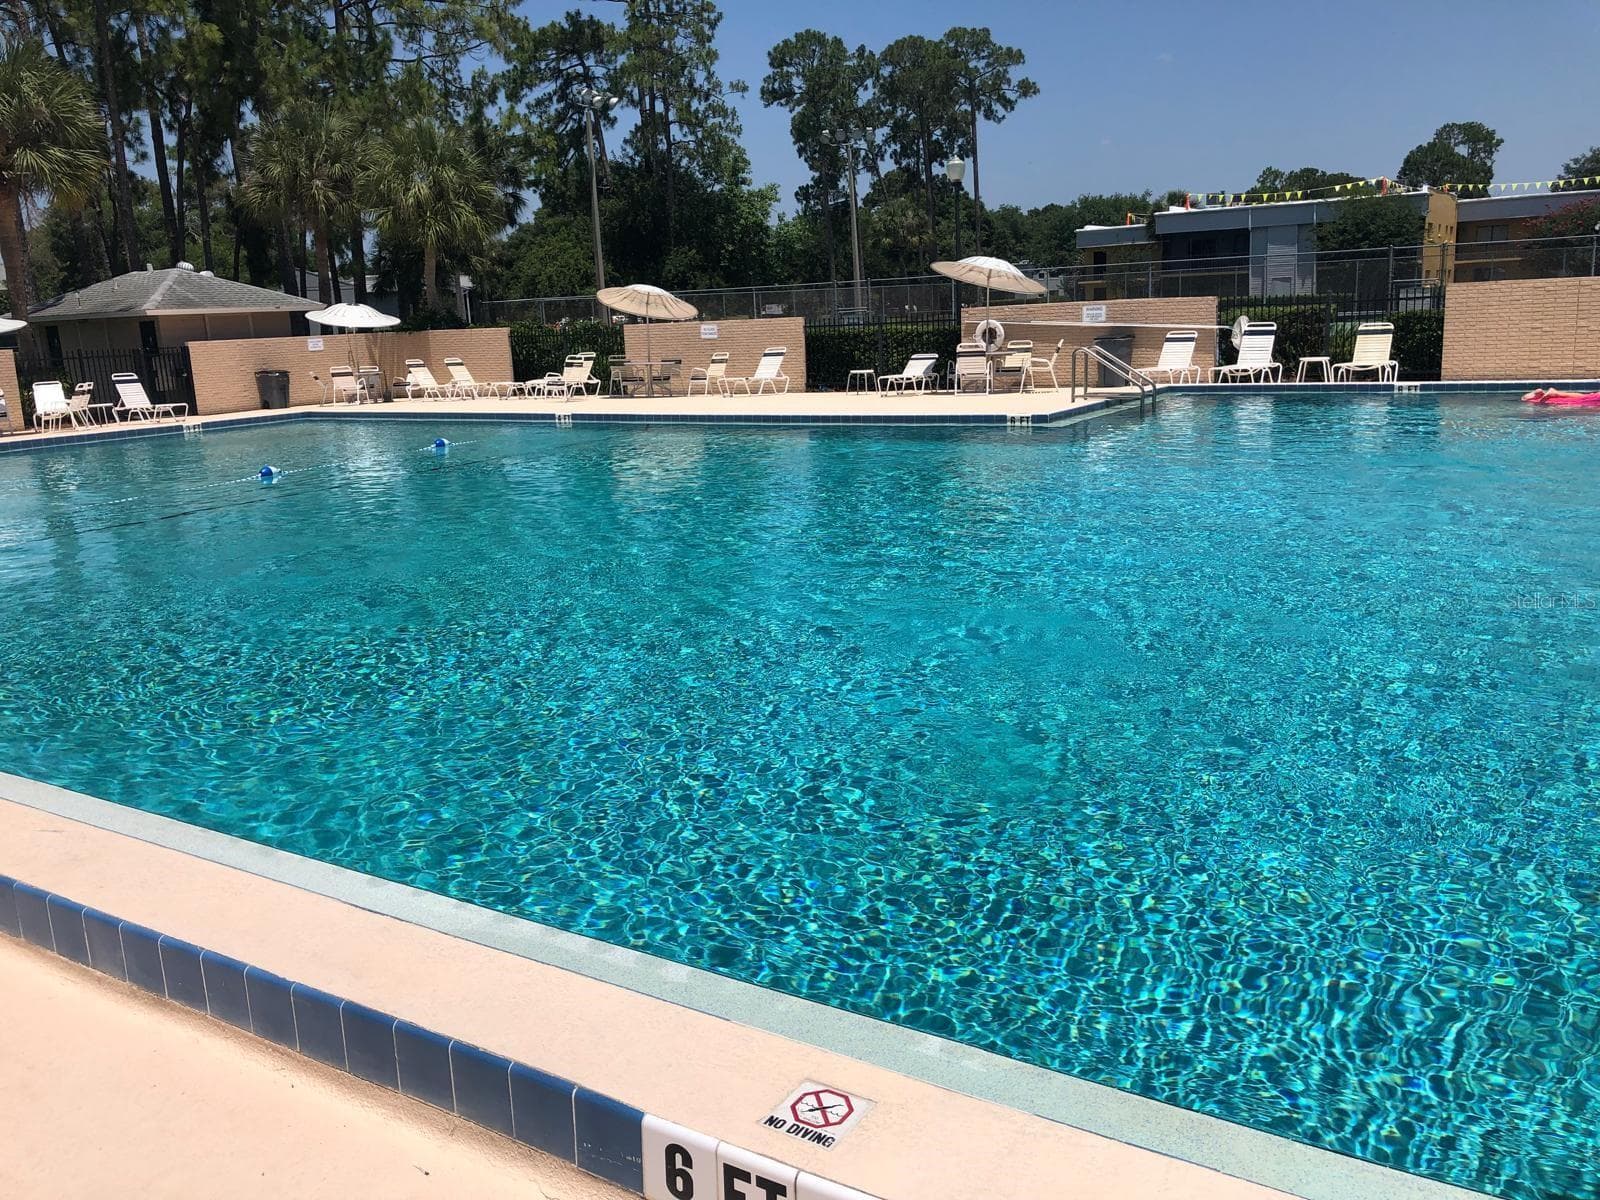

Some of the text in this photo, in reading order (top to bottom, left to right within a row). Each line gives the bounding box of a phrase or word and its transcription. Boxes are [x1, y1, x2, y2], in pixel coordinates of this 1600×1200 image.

[1020, 416, 1031, 425] FT
[763, 1115, 836, 1148] NO DIVING
[665, 1143, 694, 1200] 6
